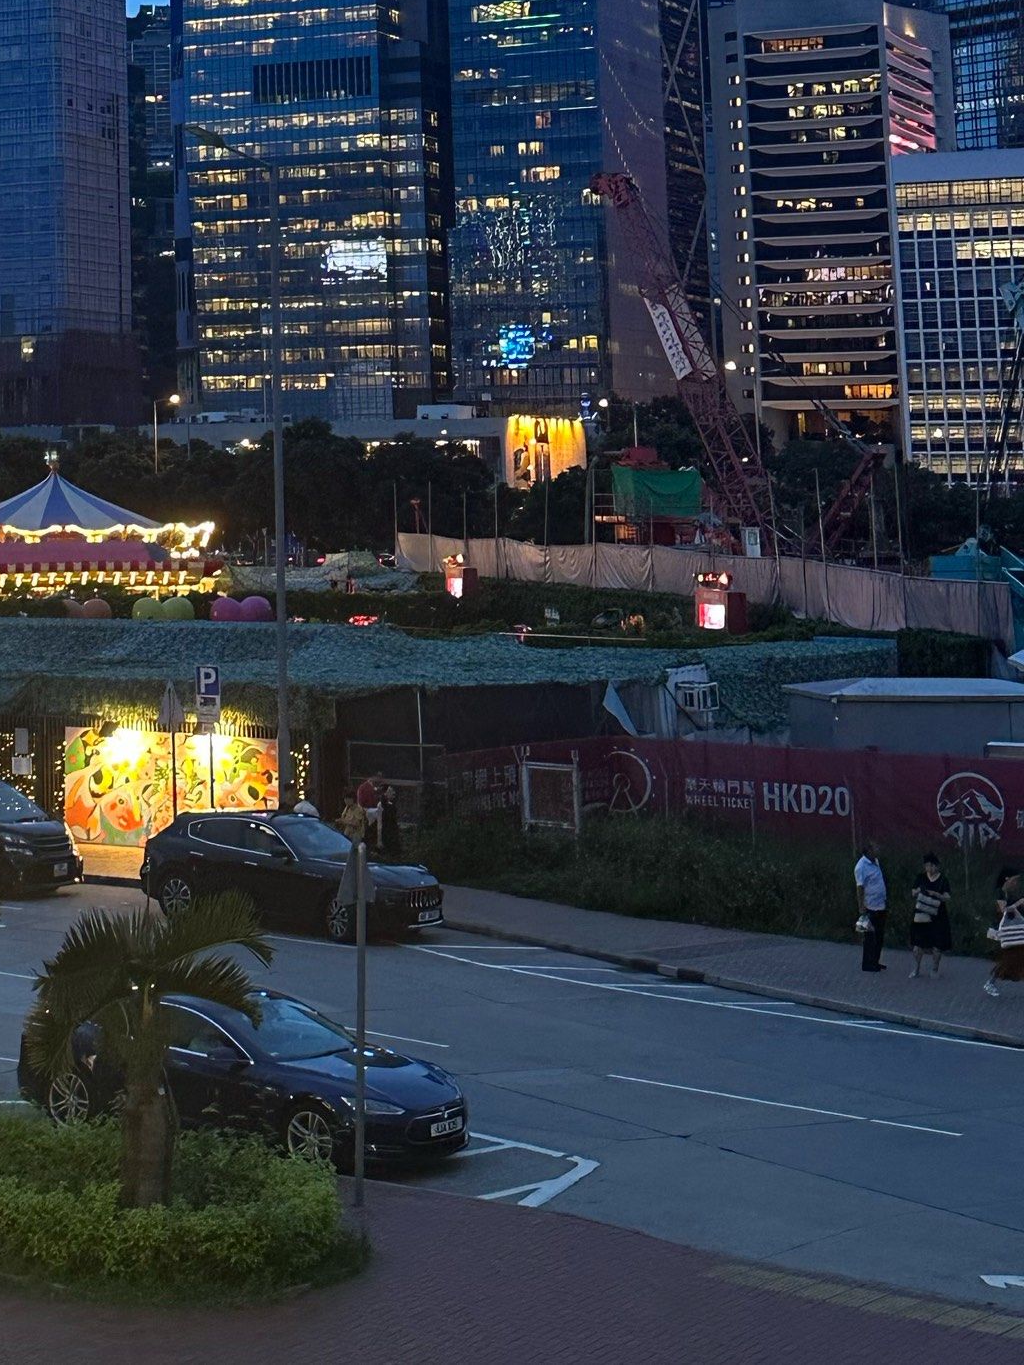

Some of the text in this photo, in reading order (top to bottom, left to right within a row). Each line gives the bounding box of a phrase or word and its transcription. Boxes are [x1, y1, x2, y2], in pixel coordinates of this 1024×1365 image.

[199, 667, 216, 693] P
[685, 794, 719, 808] WHEEL
[762, 781, 851, 817] HKD20
[942, 820, 1001, 849] AIA
